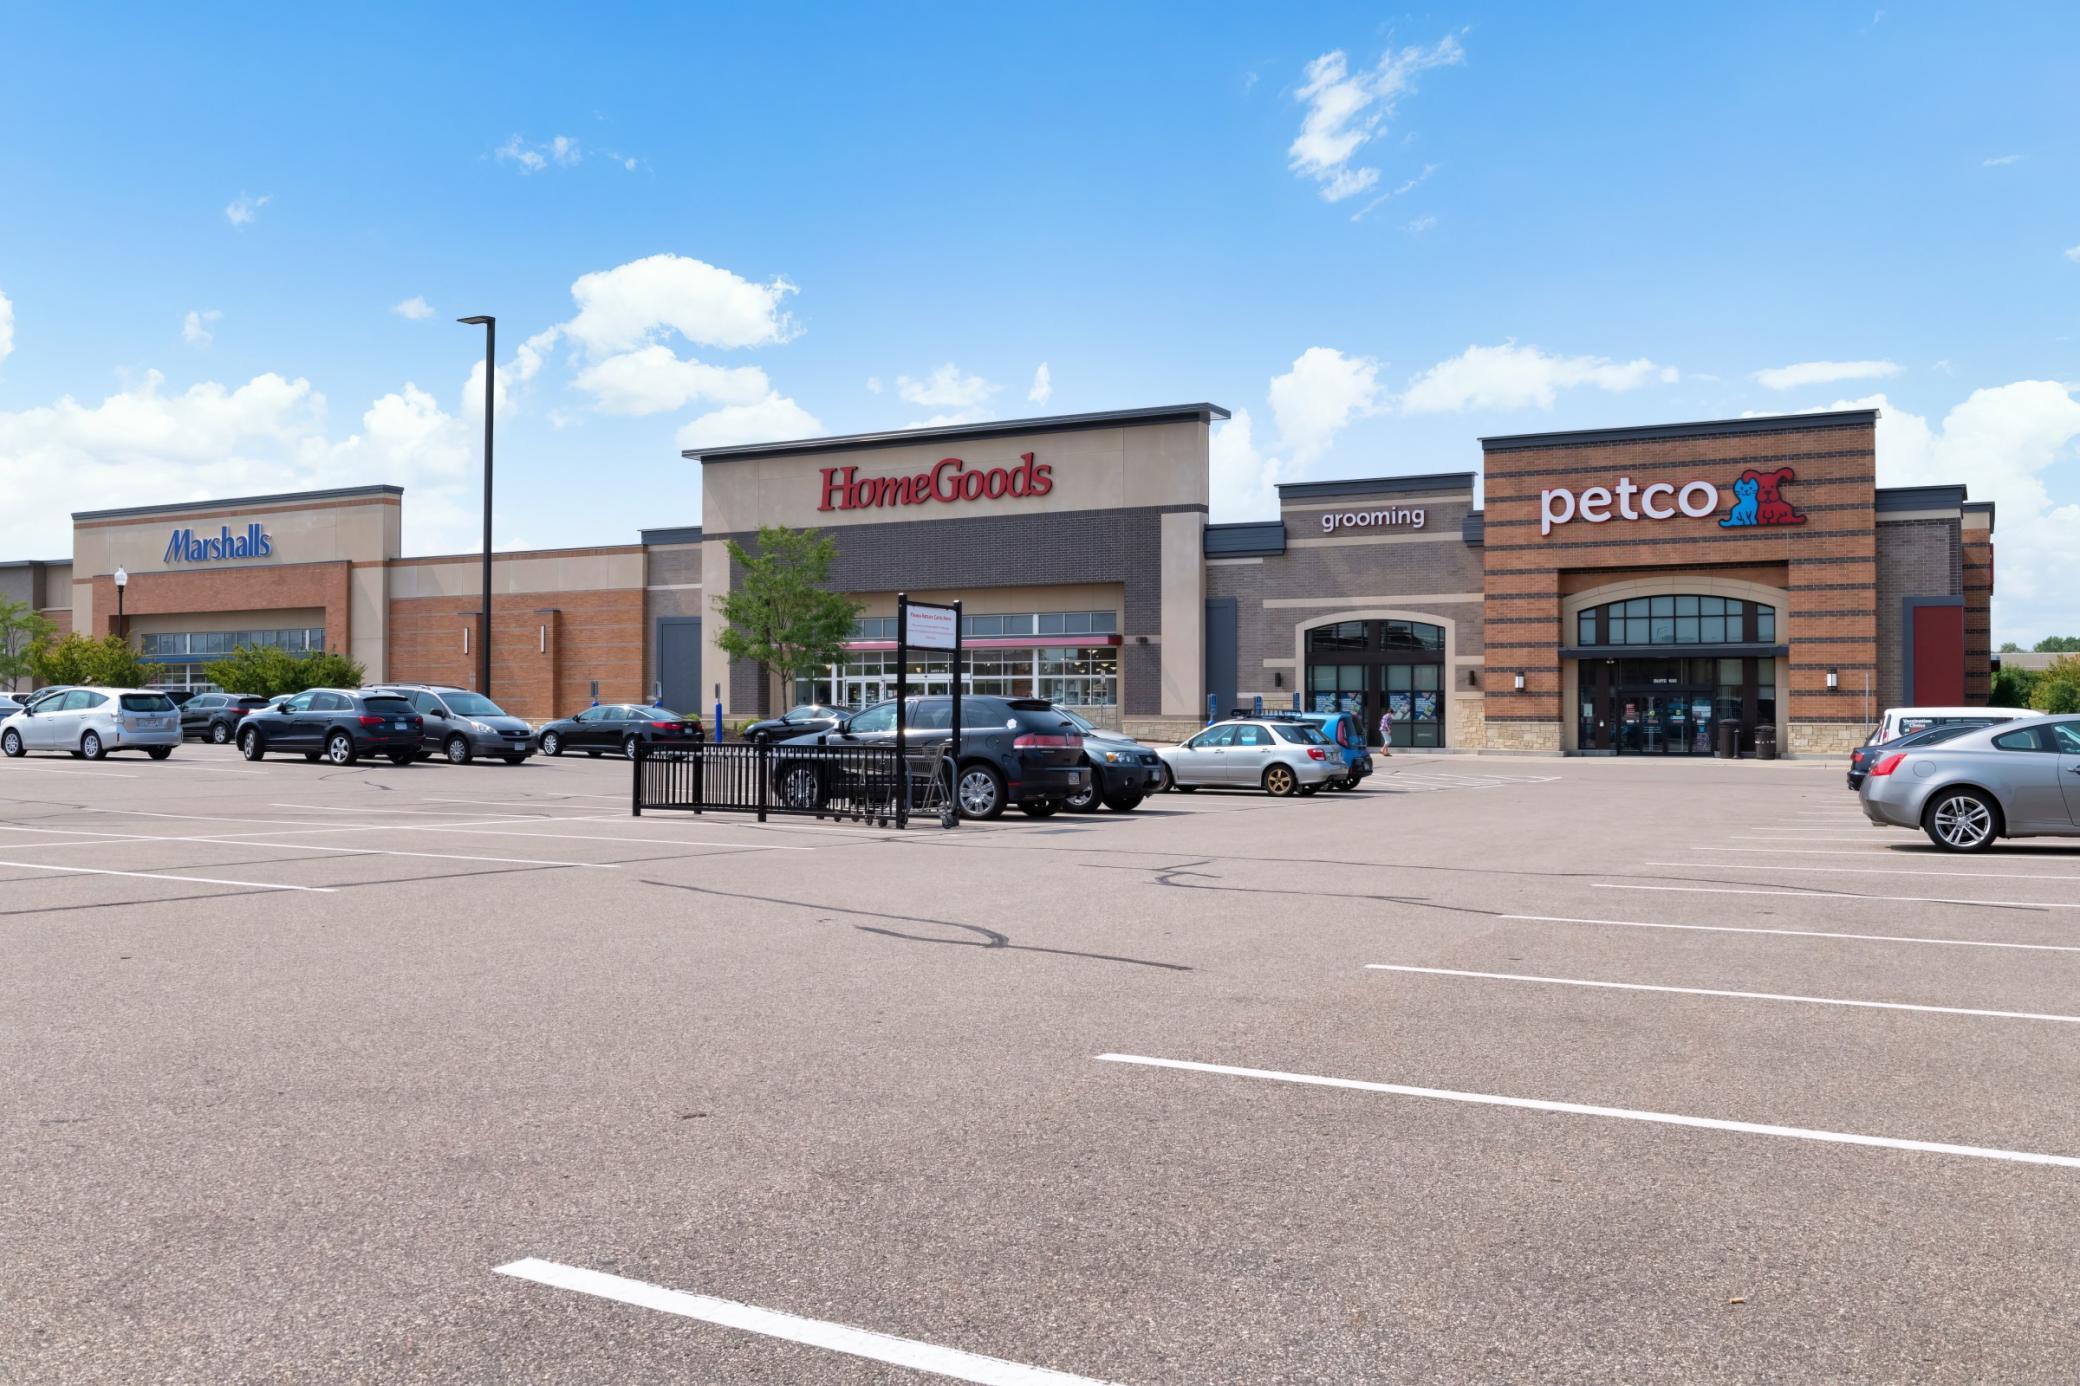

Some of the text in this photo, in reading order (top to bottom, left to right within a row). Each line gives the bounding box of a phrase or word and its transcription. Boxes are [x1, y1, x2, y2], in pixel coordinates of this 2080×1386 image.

[817, 452, 1053, 511] HomeGoods
[1321, 506, 1425, 533] grooming
[1541, 477, 1719, 536] petco
[163, 523, 273, 563] Marshalls
